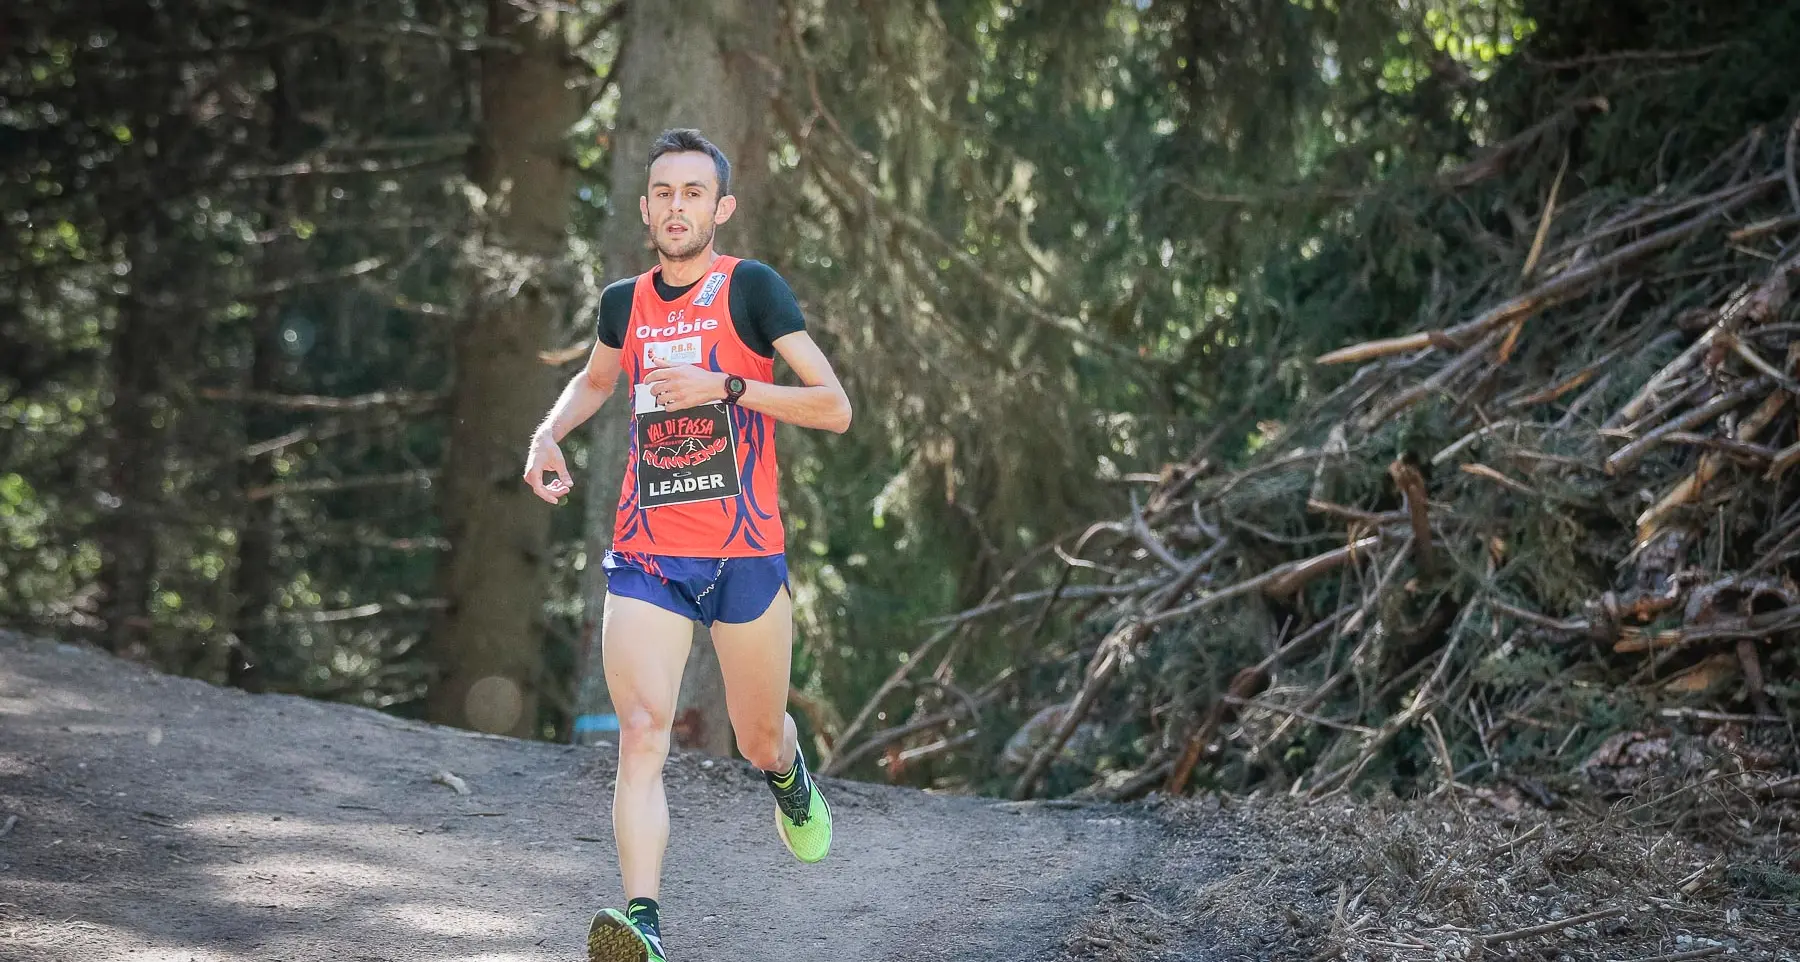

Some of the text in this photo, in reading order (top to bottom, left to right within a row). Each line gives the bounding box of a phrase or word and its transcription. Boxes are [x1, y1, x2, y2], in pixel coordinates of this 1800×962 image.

[636, 318, 718, 339] Orobie
[647, 422, 665, 442] VAL
[677, 417, 714, 436] FASSA
[643, 436, 727, 469] RUNNING
[649, 474, 725, 497] LEADER
